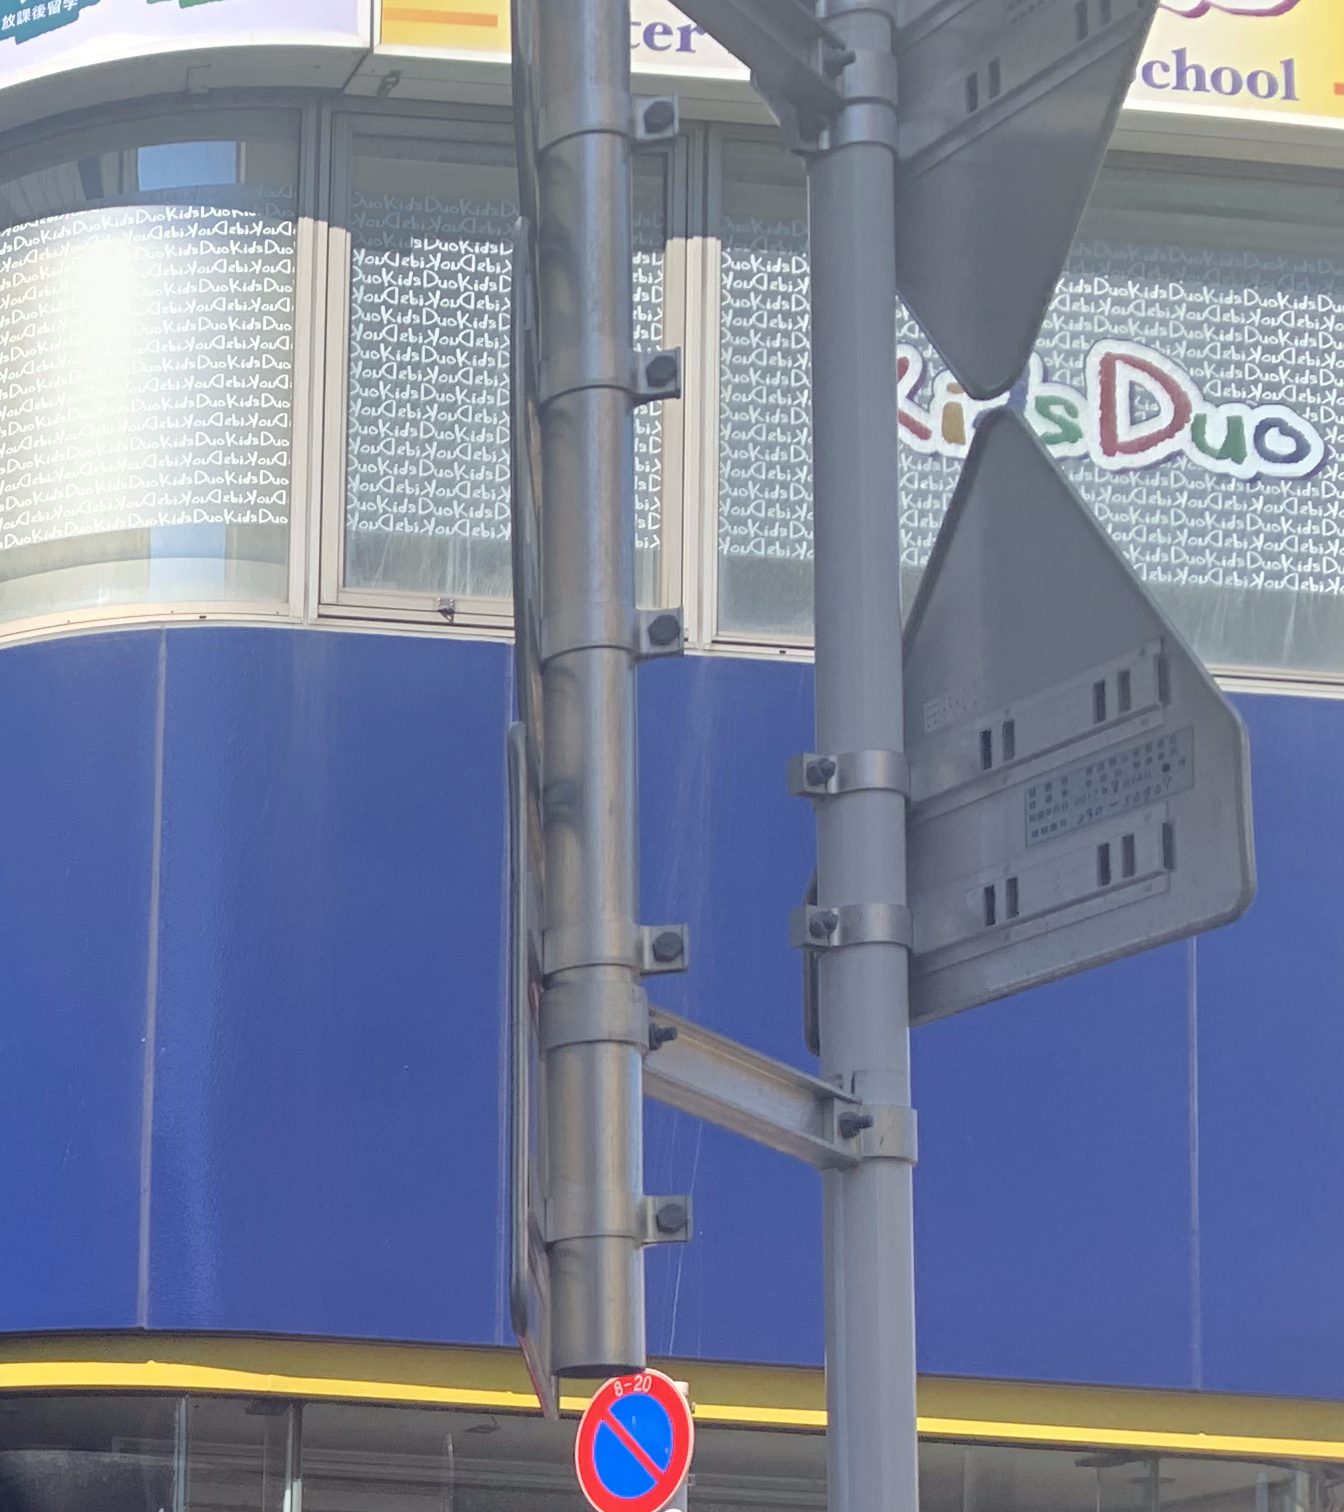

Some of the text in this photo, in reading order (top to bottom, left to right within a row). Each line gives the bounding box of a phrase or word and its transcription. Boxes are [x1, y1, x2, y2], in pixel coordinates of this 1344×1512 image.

[1, 0, 79, 30] 放課後留学
[1141, 46, 1300, 101] chool
[614, 1374, 653, 1397] 8-20
